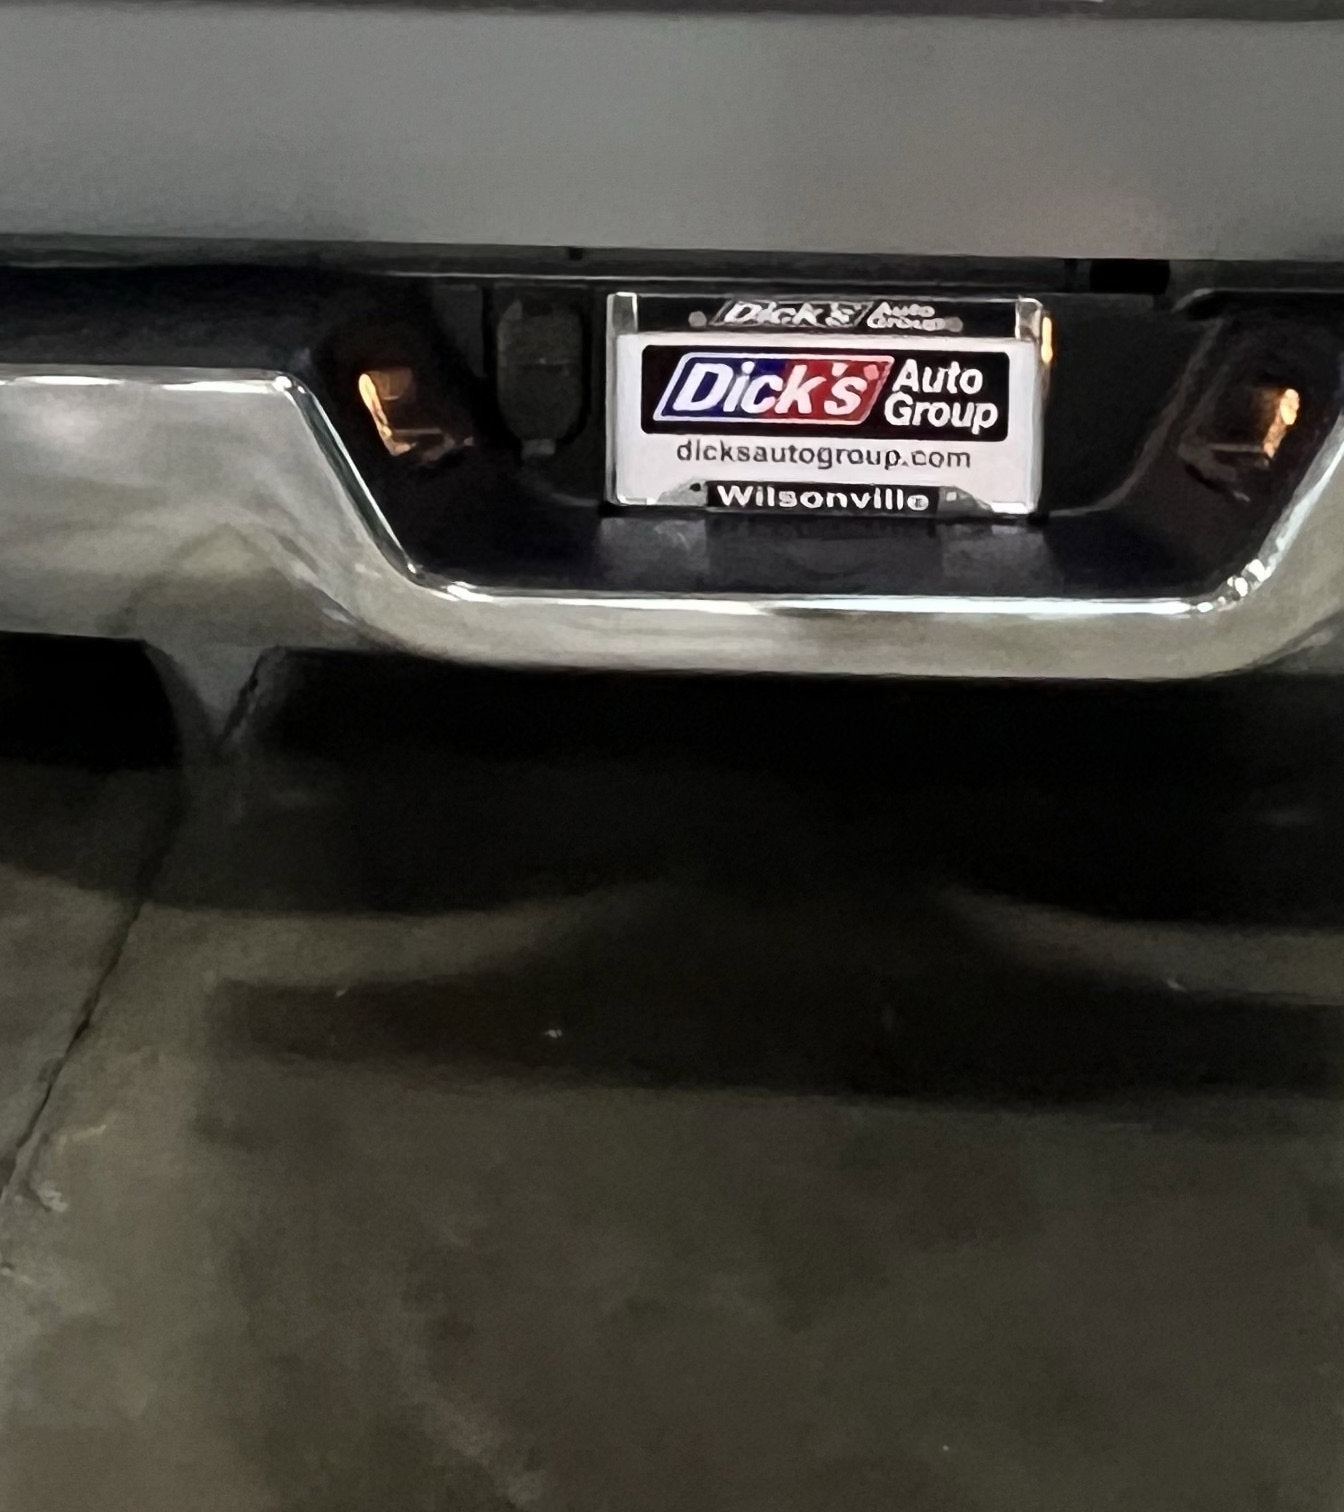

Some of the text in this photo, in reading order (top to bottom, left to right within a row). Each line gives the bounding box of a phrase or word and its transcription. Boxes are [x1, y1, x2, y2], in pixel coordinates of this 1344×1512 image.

[672, 359, 984, 417] Dick's Auto
[884, 393, 998, 434] Group
[675, 439, 971, 470] dicksautogroup.com
[716, 484, 930, 512] Wilsonville
